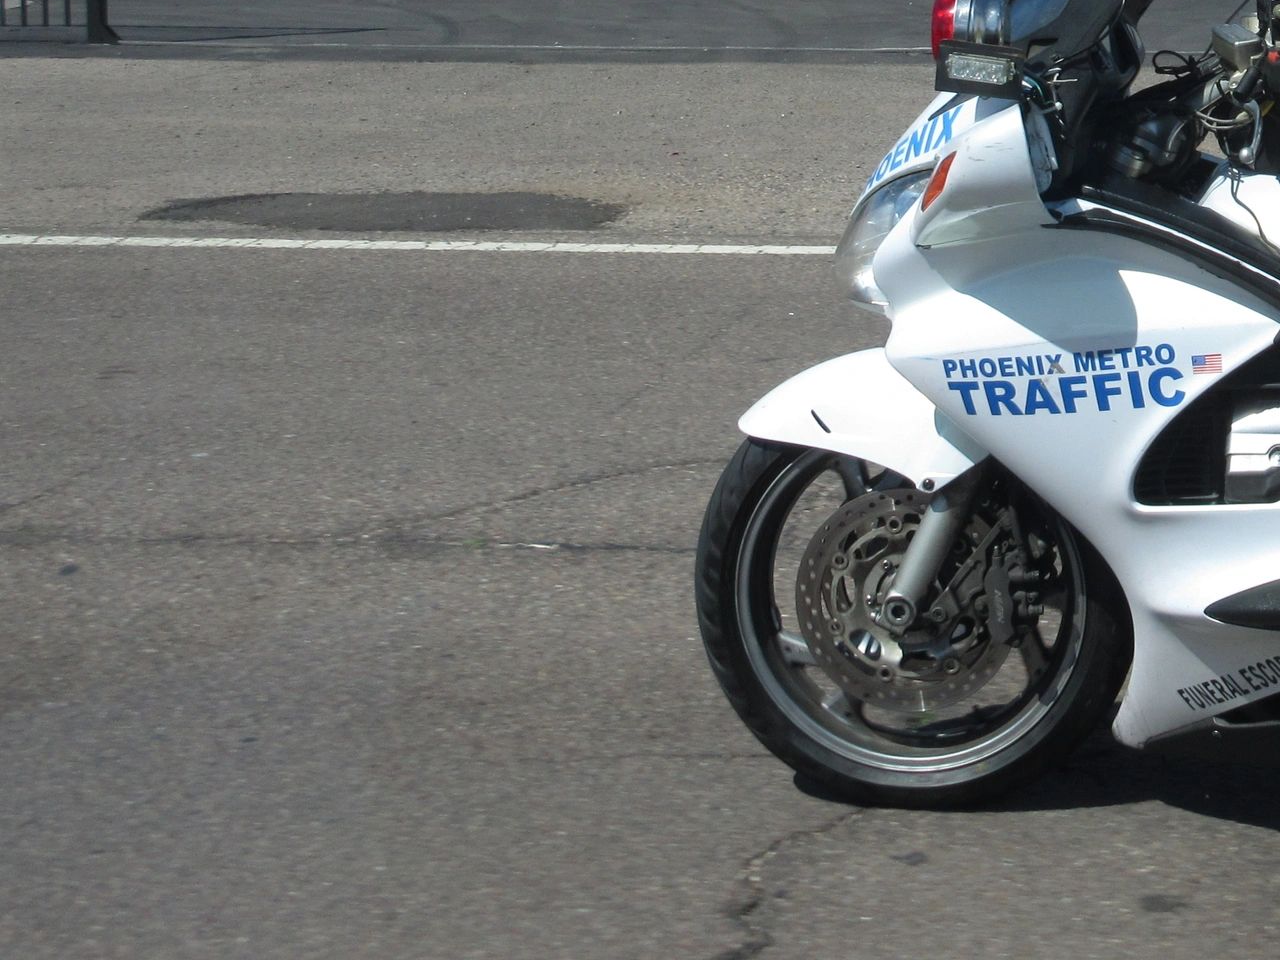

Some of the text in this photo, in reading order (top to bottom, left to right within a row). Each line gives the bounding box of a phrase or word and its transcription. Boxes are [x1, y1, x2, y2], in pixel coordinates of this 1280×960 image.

[942, 343, 1176, 379] PHOENIX METRO
[947, 367, 1186, 416] TRAFFIC
[1177, 674, 1250, 711] FUNERAL
